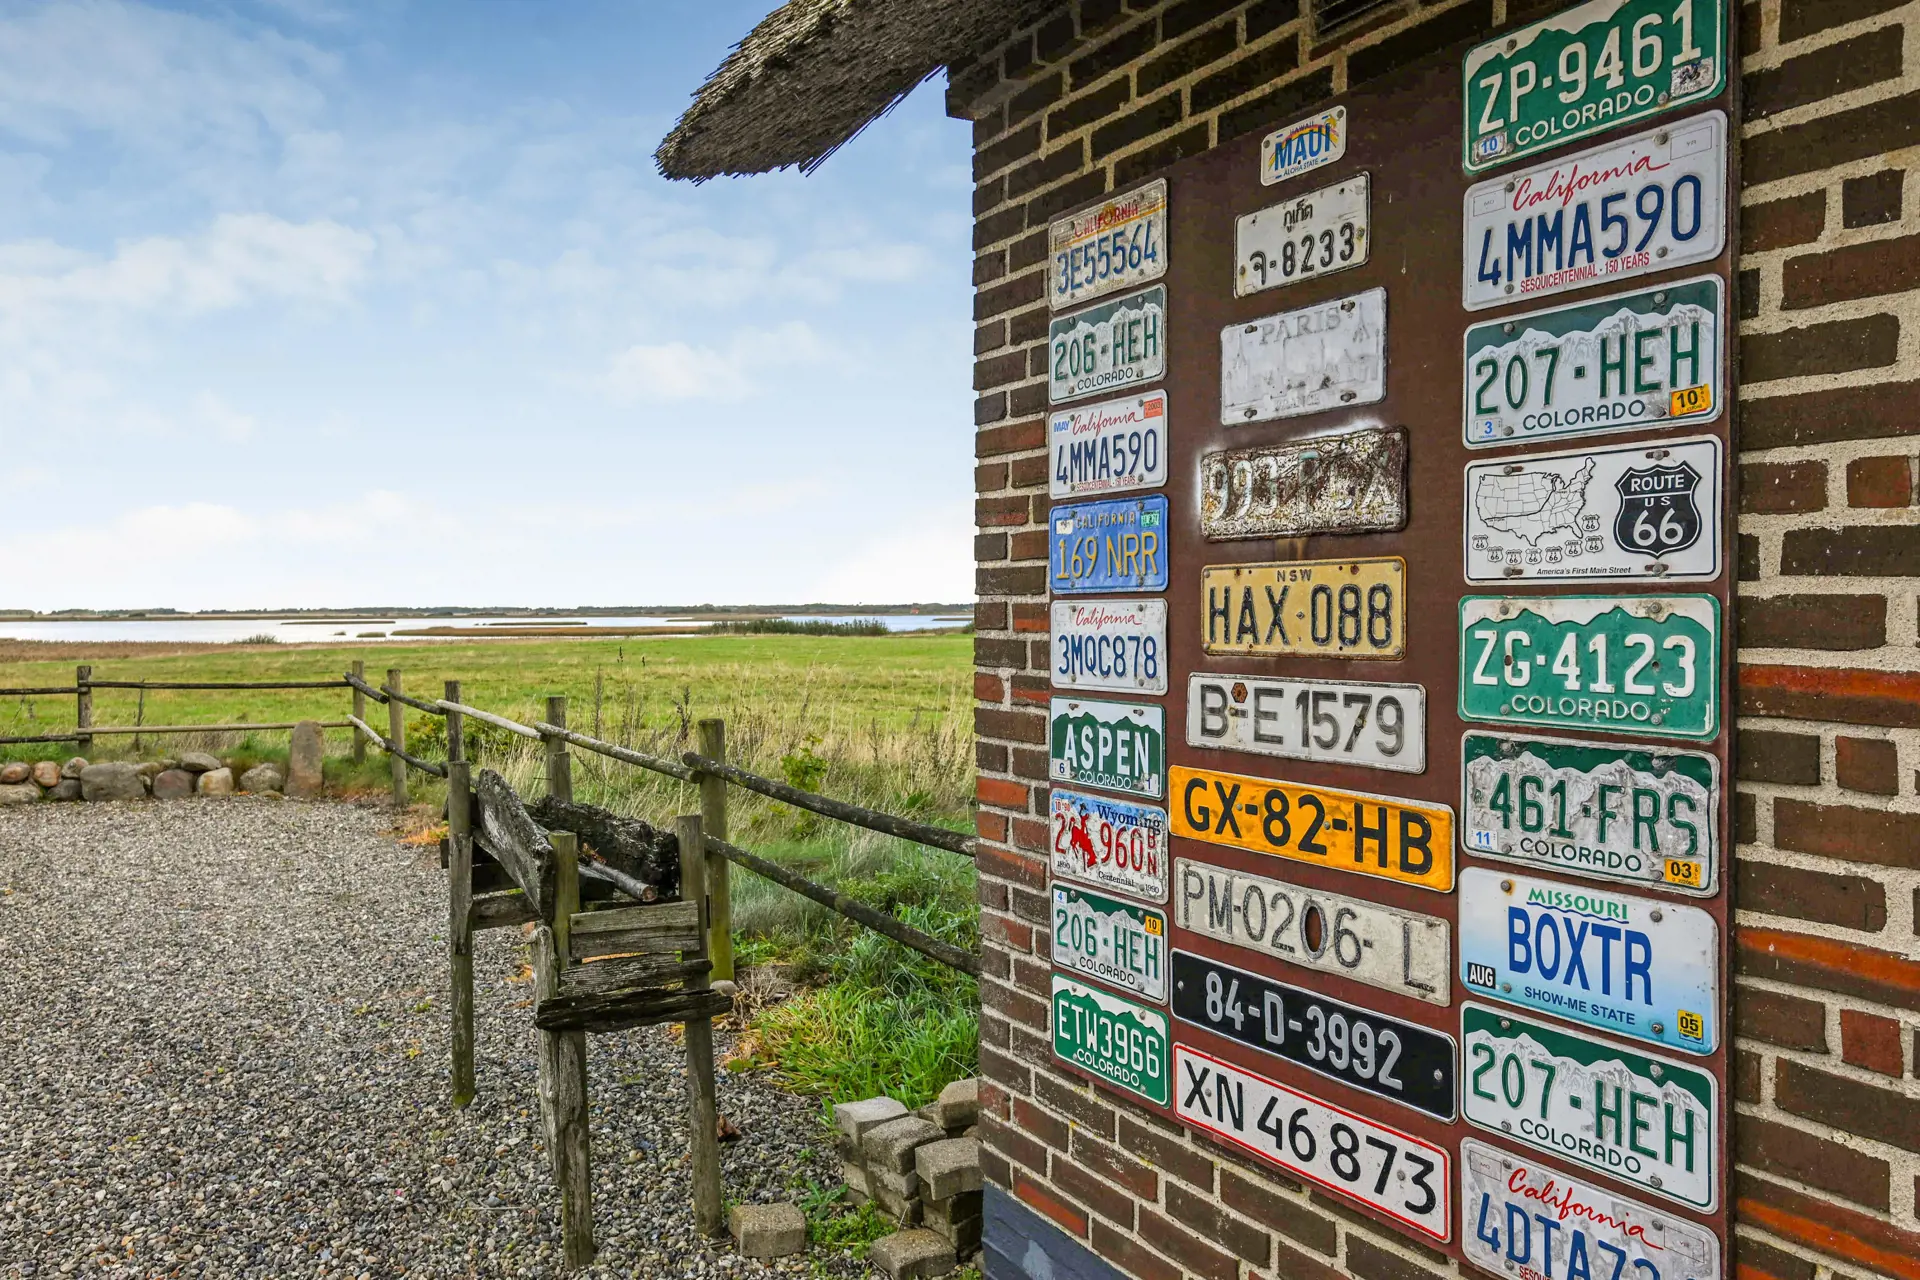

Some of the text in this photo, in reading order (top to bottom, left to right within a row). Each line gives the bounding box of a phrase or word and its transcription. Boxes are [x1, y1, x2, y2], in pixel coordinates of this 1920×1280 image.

[1515, 85, 1654, 146] COLORADO
[1275, 123, 1330, 171] MAUI
[1482, 136, 1498, 153] 10
[1303, 158, 1319, 170] STATE
[1513, 151, 1670, 212] California
[1074, 201, 1138, 237] CALIFORNIA
[1477, 175, 1701, 286] 4MMA590
[1057, 220, 1157, 294] 3E55564
[1520, 252, 1649, 293] SESQUICENTENNIAL 150 YEARS
[1259, 307, 1341, 345] PARIS
[1077, 367, 1134, 391] COLORADO
[1522, 400, 1646, 430] COLORADO
[1677, 390, 1698, 408] 10
[1053, 420, 1070, 433] MAY
[1072, 407, 1144, 437] California
[1484, 421, 1493, 434] 3
[1056, 428, 1157, 485] 4MMA590
[1631, 473, 1685, 491] ROUTE
[1076, 511, 1136, 529] CALIFORNIA
[1633, 507, 1684, 546] 66
[1056, 531, 1158, 579] 169 NRR
[1572, 567, 1588, 575] First
[1608, 566, 1631, 574] Street
[1277, 568, 1312, 582] NSW
[1076, 607, 1143, 630] California
[1058, 634, 1157, 679] 3MQC878
[1295, 688, 1404, 757] 1579
[1511, 695, 1650, 721] COLORADO
[1063, 724, 1149, 777] ASPEN
[1059, 762, 1065, 774] 6
[1078, 771, 1132, 790] COLORADO
[1096, 804, 1161, 836] Wyoming
[1184, 777, 1433, 875] GX-82-HB
[1476, 831, 1490, 845] 11
[1520, 837, 1642, 872] COLORADO
[1671, 861, 1691, 878] 03
[1098, 871, 1135, 887] Centennial
[1145, 884, 1159, 894] 1990
[1528, 887, 1629, 920] MISSOURI
[1148, 918, 1157, 930] 10
[1079, 957, 1135, 985] COLORADO
[1508, 906, 1653, 1005] BOXTR
[1469, 965, 1495, 987] AUG
[1524, 986, 1635, 1025] SHOW-ME STATE
[1058, 998, 1159, 1079] ETW3966
[1205, 971, 1403, 1090] 84-D-3992
[1680, 1016, 1698, 1032] 05
[1076, 1048, 1140, 1087] COLORADO
[1520, 1118, 1642, 1173] COLORADO
[1508, 1167, 1664, 1250] California
[1477, 1192, 1694, 1280] 4DTA7
